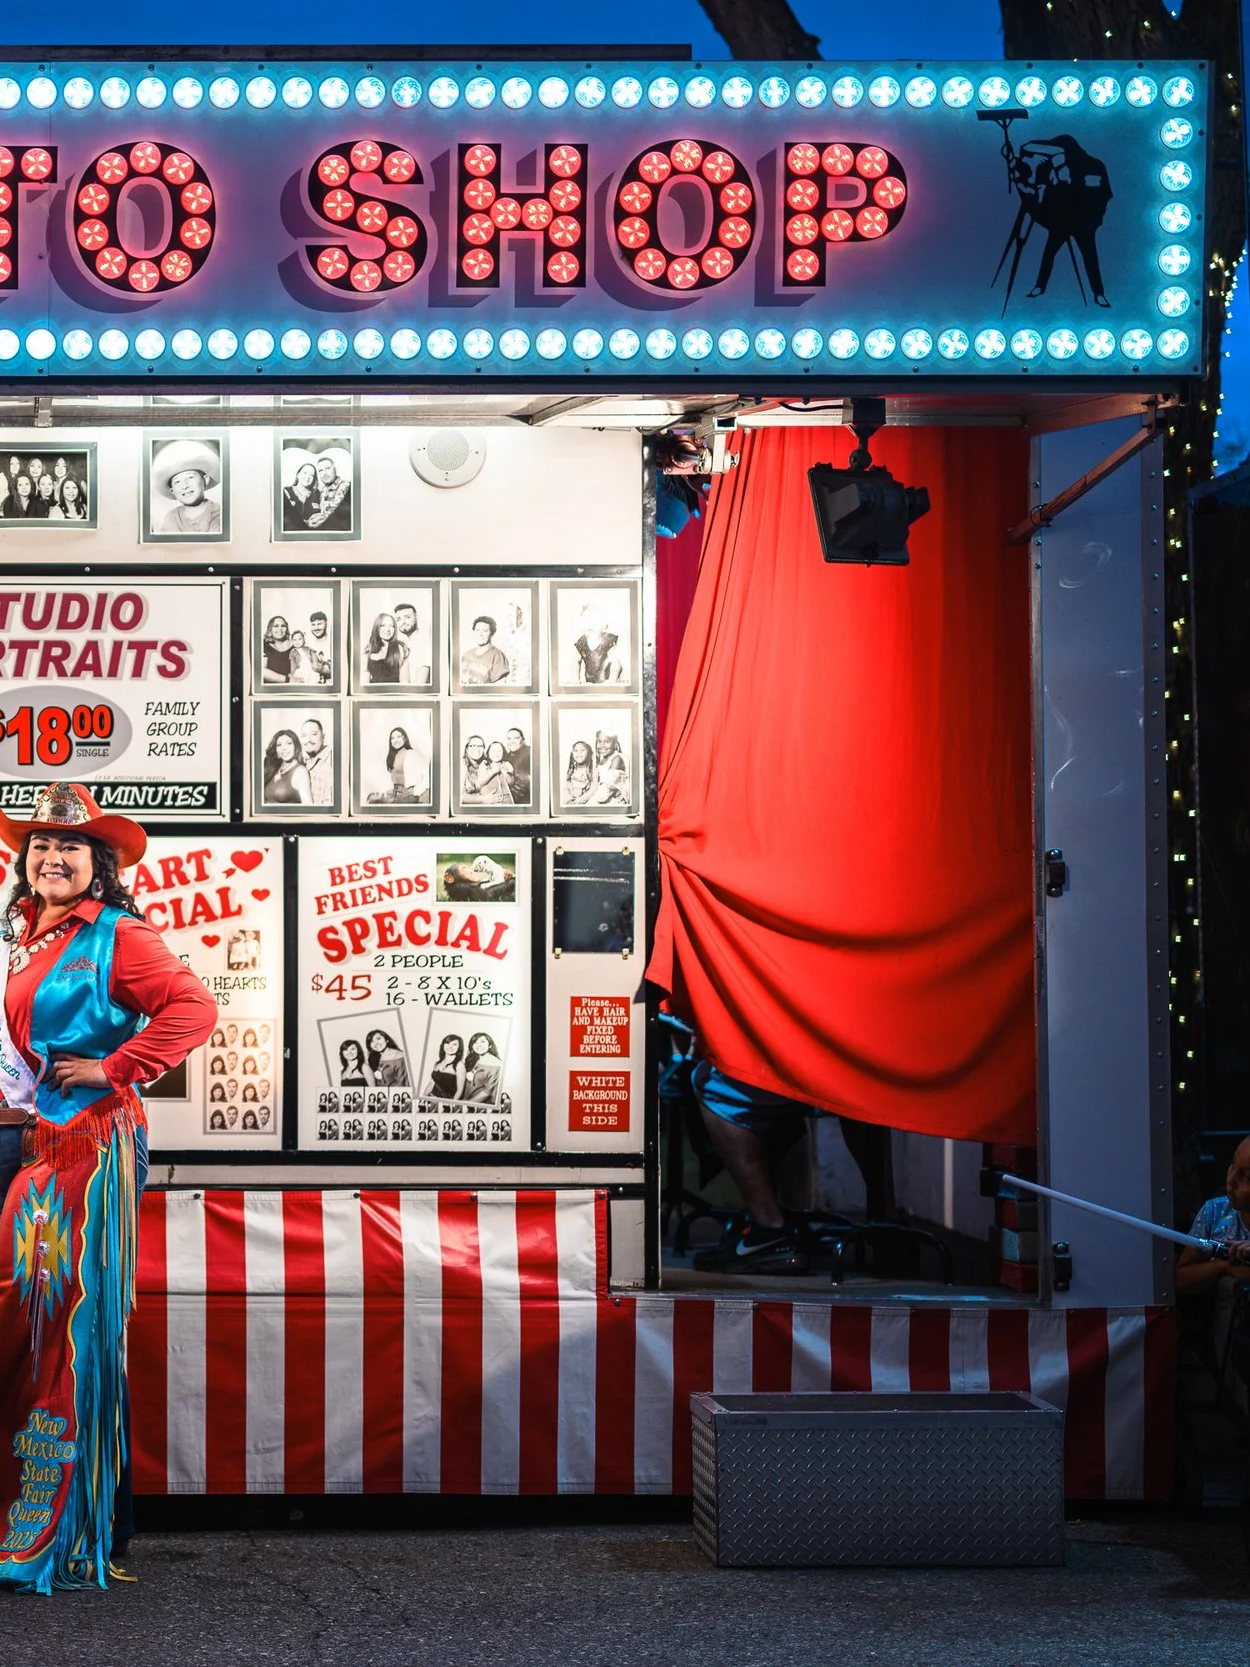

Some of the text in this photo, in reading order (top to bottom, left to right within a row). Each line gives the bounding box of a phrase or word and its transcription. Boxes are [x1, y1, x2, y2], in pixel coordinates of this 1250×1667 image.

[306, 139, 908, 292] SHOP
[145, 701, 200, 716] FAMILY
[147, 721, 198, 737] GROUP
[76, 747, 109, 757] SINGLE
[148, 742, 197, 757] RATES
[100, 785, 209, 807] MINUTES
[328, 856, 393, 887] BEST
[315, 873, 430, 915] FRIENDS
[317, 909, 509, 963] SPECIAL
[374, 954, 464, 968] 2 PEOPLE
[213, 976, 267, 990] HEARTS
[311, 973, 372, 1001] $45
[387, 976, 399, 989] 2
[417, 976, 431, 989] 8
[437, 976, 451, 989] X
[458, 976, 491, 989] 10's
[386, 992, 405, 1006] 16
[425, 992, 513, 1006] WALLETS
[575, 1007, 625, 1016] HAVE HAIR
[573, 1017, 628, 1025] AND MAKEUP
[587, 1026, 614, 1035] FIXED
[583, 1035, 617, 1044] BEFORE
[580, 1044, 621, 1054] ENTERING
[577, 1077, 625, 1086] WHITE
[573, 1090, 628, 1100] BACKGROUND
[583, 1104, 618, 1112] THIS
[582, 1116, 618, 1125] SIDE
[28, 1412, 65, 1435] New
[14, 1434, 75, 1460] Mexico
[22, 1459, 60, 1482] State
[22, 1482, 55, 1504] Fair
[8, 1501, 51, 1527] Queen
